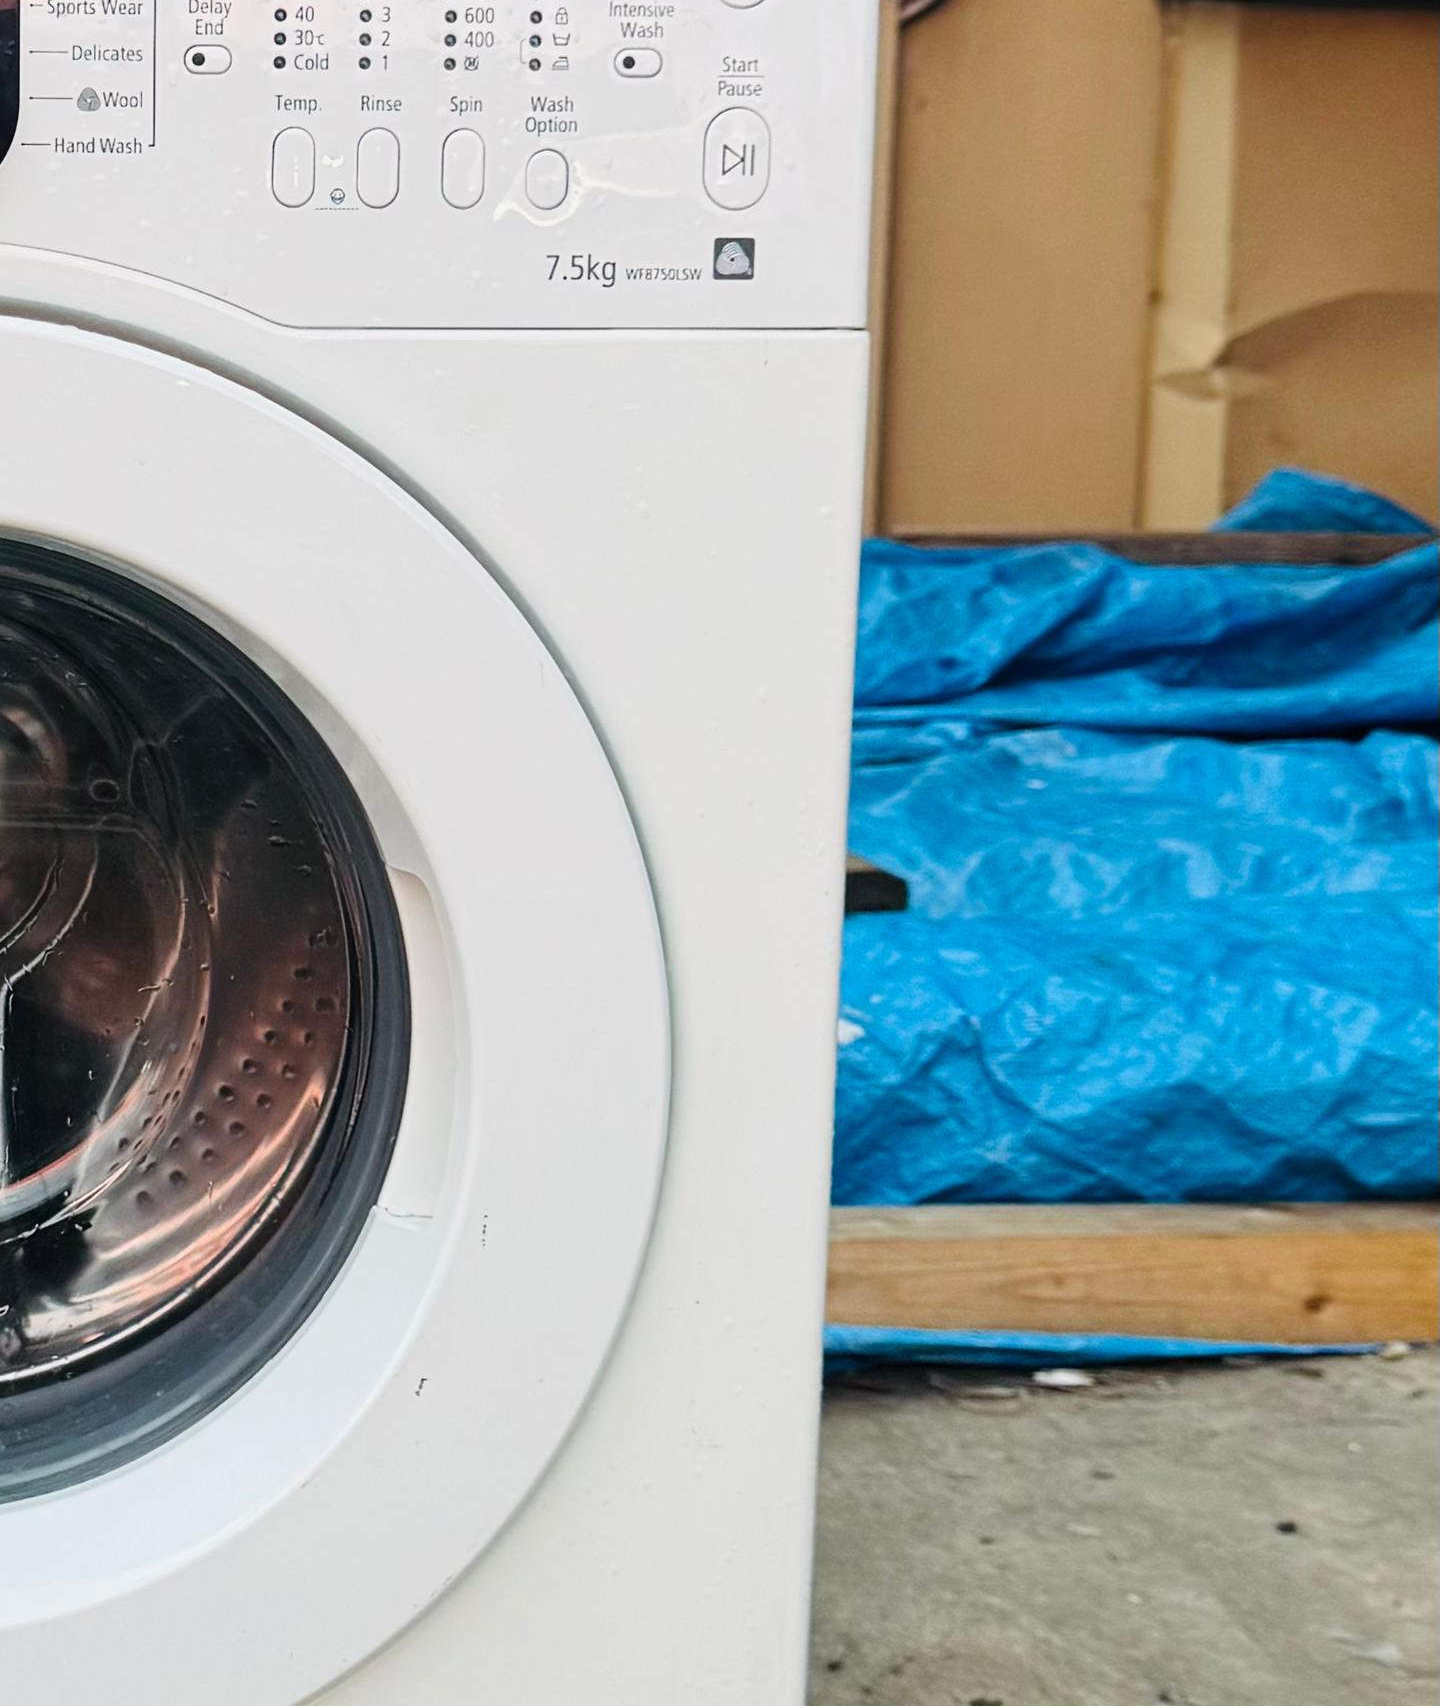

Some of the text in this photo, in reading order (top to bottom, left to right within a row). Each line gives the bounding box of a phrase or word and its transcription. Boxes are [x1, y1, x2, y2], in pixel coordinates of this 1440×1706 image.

[47, 0, 98, 17] Sports
[294, 7, 315, 22] 40
[381, 7, 391, 23] 3
[464, 8, 495, 24] 600
[609, 2, 675, 18] Intensive
[195, 19, 225, 36] End
[620, 22, 664, 39] Wash
[381, 32, 391, 47] 2
[464, 32, 495, 48] 400
[71, 45, 144, 62] Delicates
[293, 54, 329, 70] Cold
[381, 56, 389, 70] 1
[722, 57, 759, 73] Start
[717, 81, 763, 97] Pause
[102, 91, 144, 109] Wool
[274, 95, 322, 115] Temp.
[360, 96, 403, 112] Rinse
[450, 96, 483, 116] Spin
[530, 96, 574, 112] Wash
[524, 117, 578, 137] Option
[54, 137, 143, 155] Hand Wash
[546, 253, 617, 288] 7.5kg
